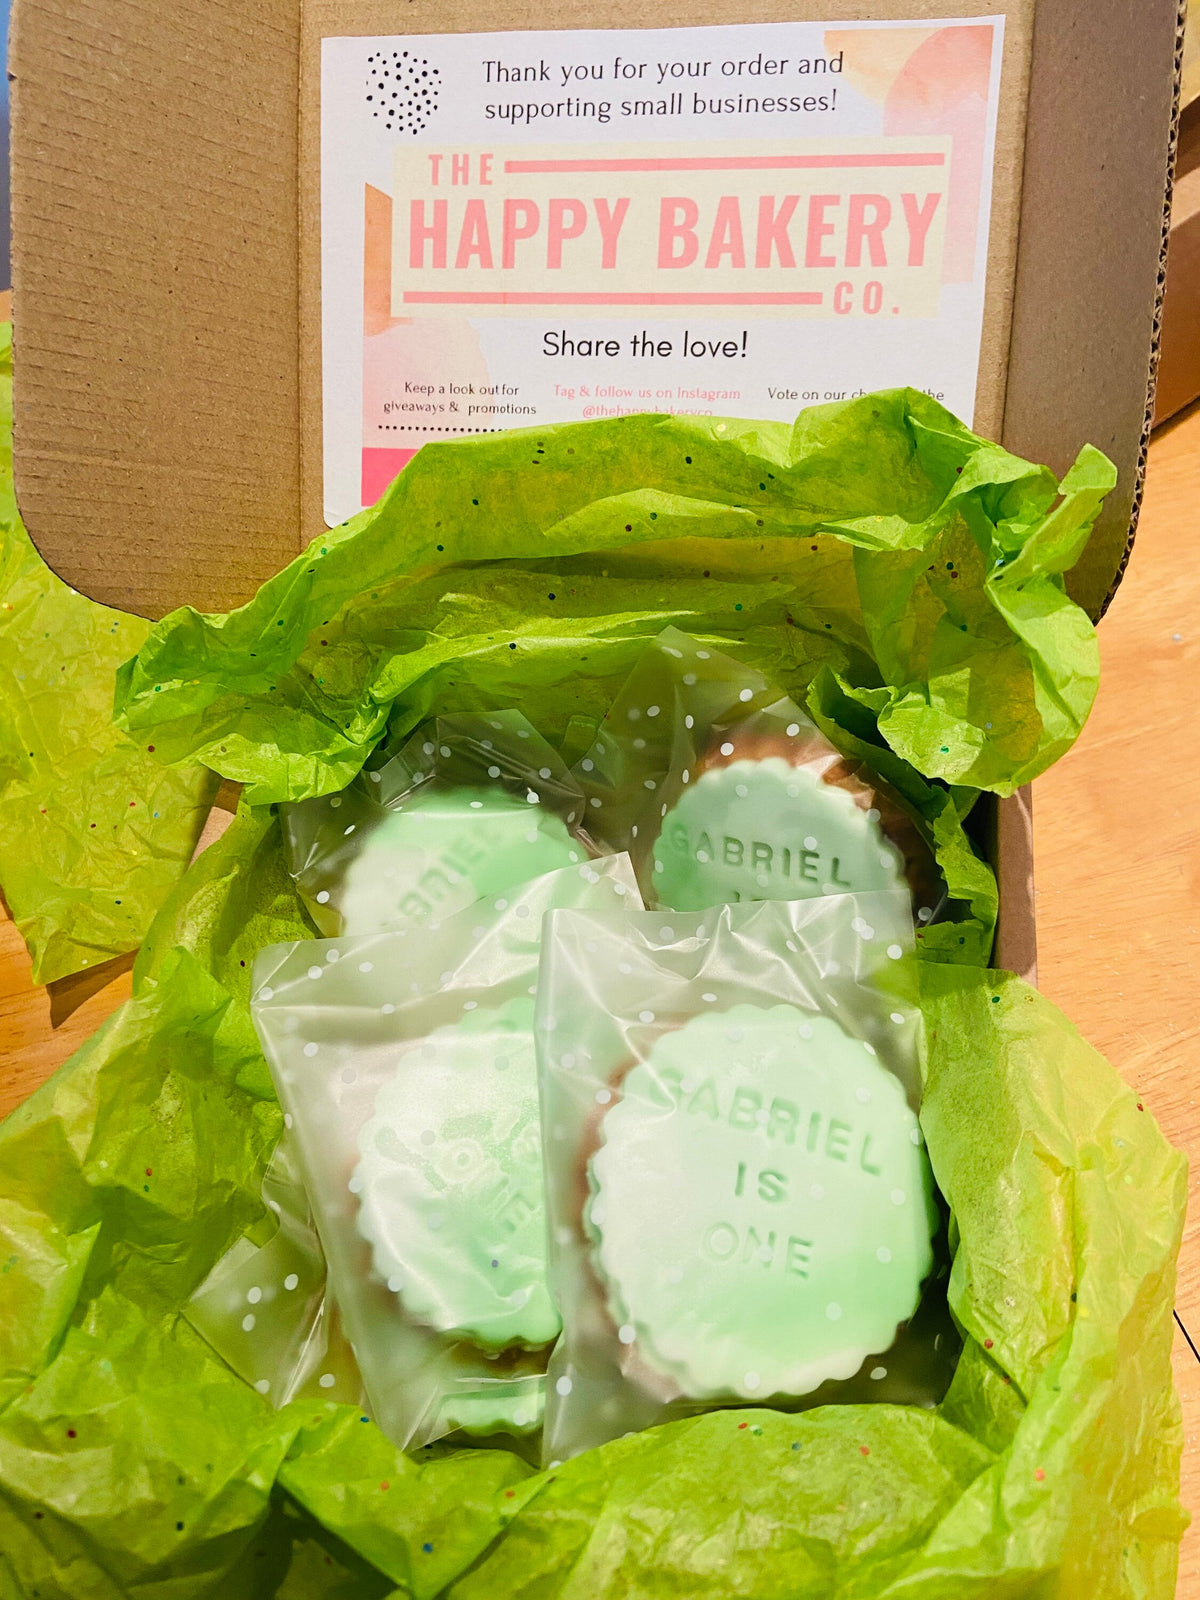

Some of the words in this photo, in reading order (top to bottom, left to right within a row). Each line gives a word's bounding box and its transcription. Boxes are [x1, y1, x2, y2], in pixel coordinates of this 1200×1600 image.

[482, 60, 551, 83] Thank
[561, 66, 604, 86] you
[613, 57, 648, 80] for
[657, 60, 712, 84] your
[721, 53, 790, 77] order
[798, 50, 844, 74] and
[485, 97, 611, 125] supporting
[621, 93, 683, 116] small
[692, 88, 838, 115] businesses!
[428, 153, 494, 186] THE
[408, 197, 631, 270] HAPPY
[656, 192, 942, 270] BAKERY
[832, 280, 900, 316] CO.
[543, 330, 620, 357] Share
[630, 330, 673, 357] the
[683, 330, 748, 358] love!
[404, 381, 435, 397] Keep
[438, 385, 445, 394] a
[449, 382, 475, 394] look
[479, 384, 499, 395] out
[502, 382, 520, 396] for
[554, 384, 575, 400] Tag
[579, 386, 590, 397] &
[595, 385, 633, 398] follow
[638, 389, 652, 398] us
[656, 390, 672, 399] on
[677, 387, 741, 402] Instagram
[767, 387, 799, 400] Vote
[802, 391, 819, 400] on
[824, 391, 847, 400] our
[383, 401, 445, 414] giveaways
[449, 401, 459, 413] &
[468, 404, 537, 416] promotions
[669, 821, 851, 888] GABRIEL
[650, 1066, 882, 1177] GABRIEL
[734, 1160, 788, 1202] IS
[702, 1221, 815, 1279] ONE
